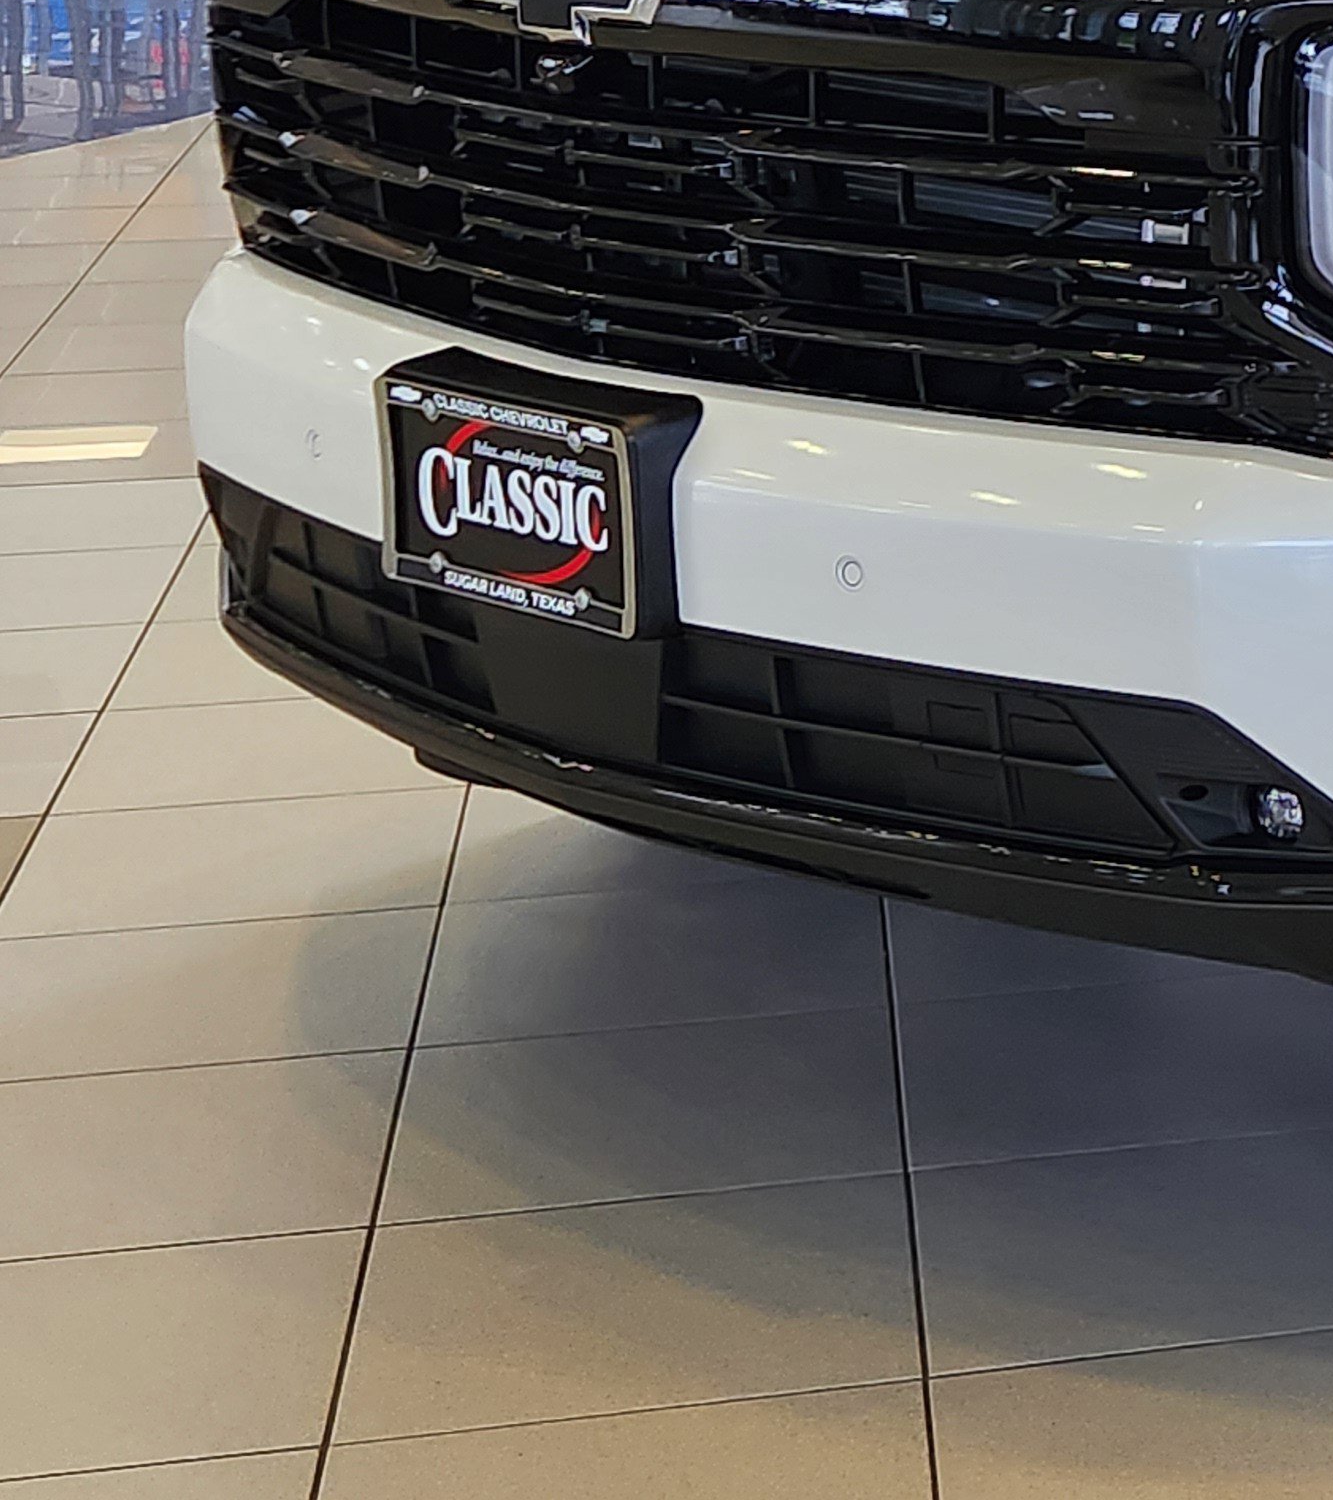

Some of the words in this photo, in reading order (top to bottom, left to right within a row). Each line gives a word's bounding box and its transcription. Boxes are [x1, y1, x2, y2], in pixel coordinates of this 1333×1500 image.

[433, 393, 489, 419] CLASSIC
[490, 405, 570, 435] CHEVROLET
[418, 446, 609, 552] CLASSIC
[444, 570, 487, 594] SUGAR
[489, 580, 529, 608] LAND,
[530, 591, 576, 617] TEXAS
